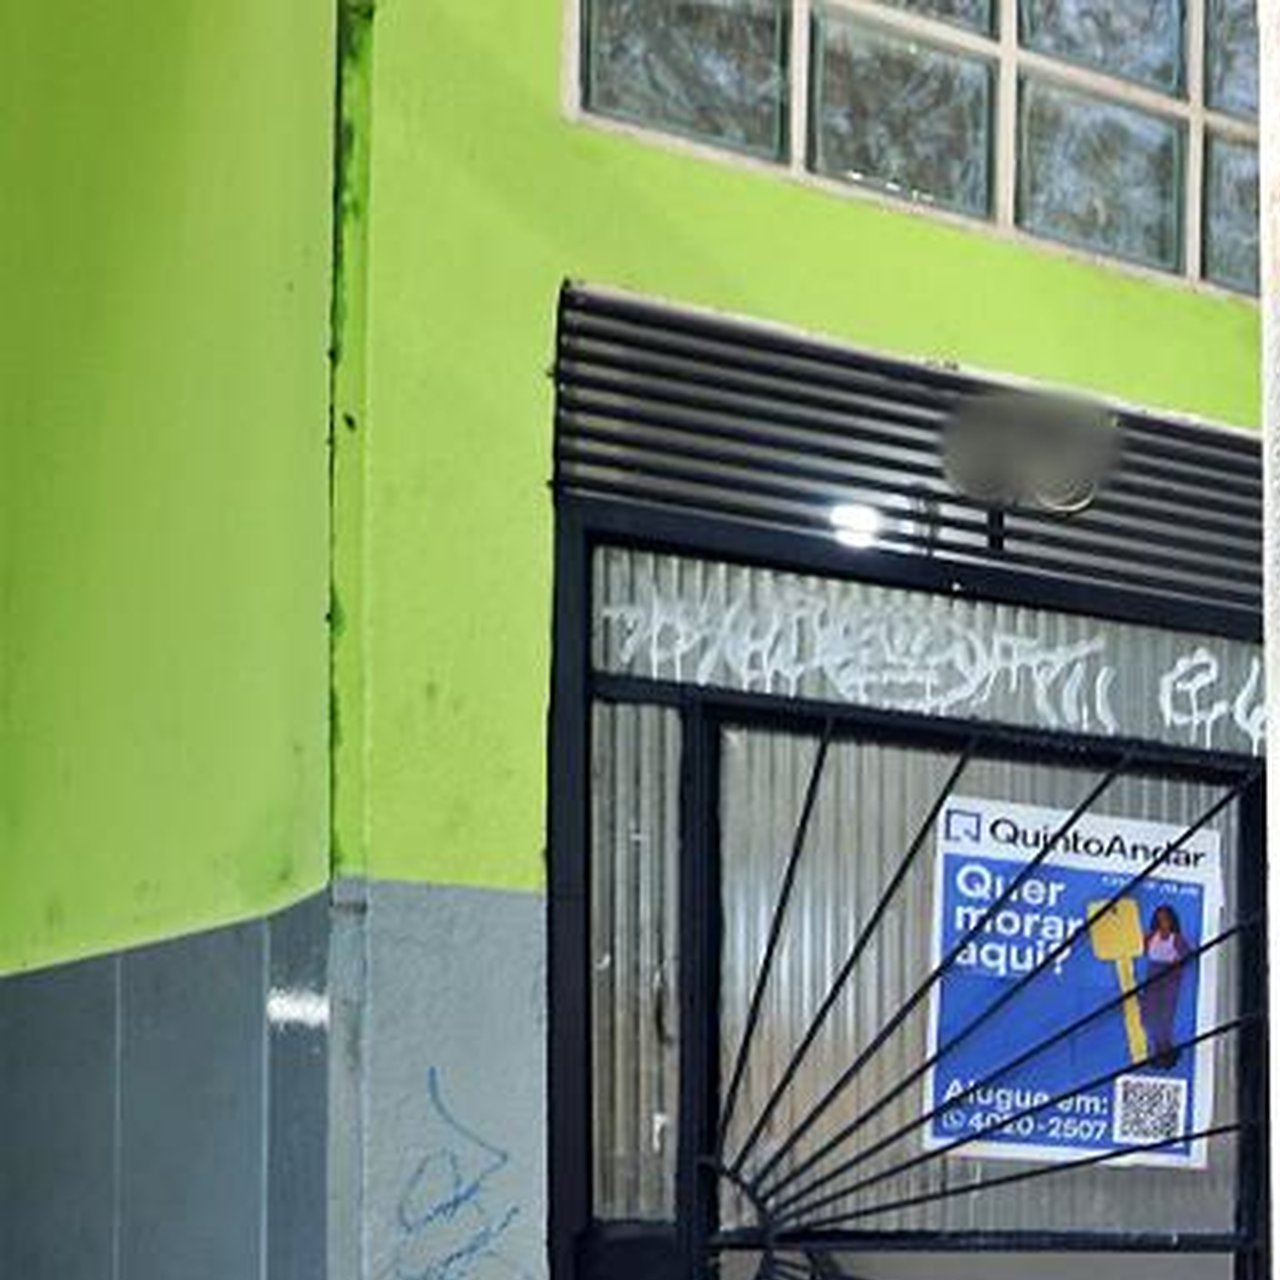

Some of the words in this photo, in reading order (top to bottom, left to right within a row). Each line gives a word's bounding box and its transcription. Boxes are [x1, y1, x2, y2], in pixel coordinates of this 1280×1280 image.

[989, 817, 1206, 867] QuintoAndar
[956, 906, 1083, 939] morar
[955, 940, 1071, 976] aqui?
